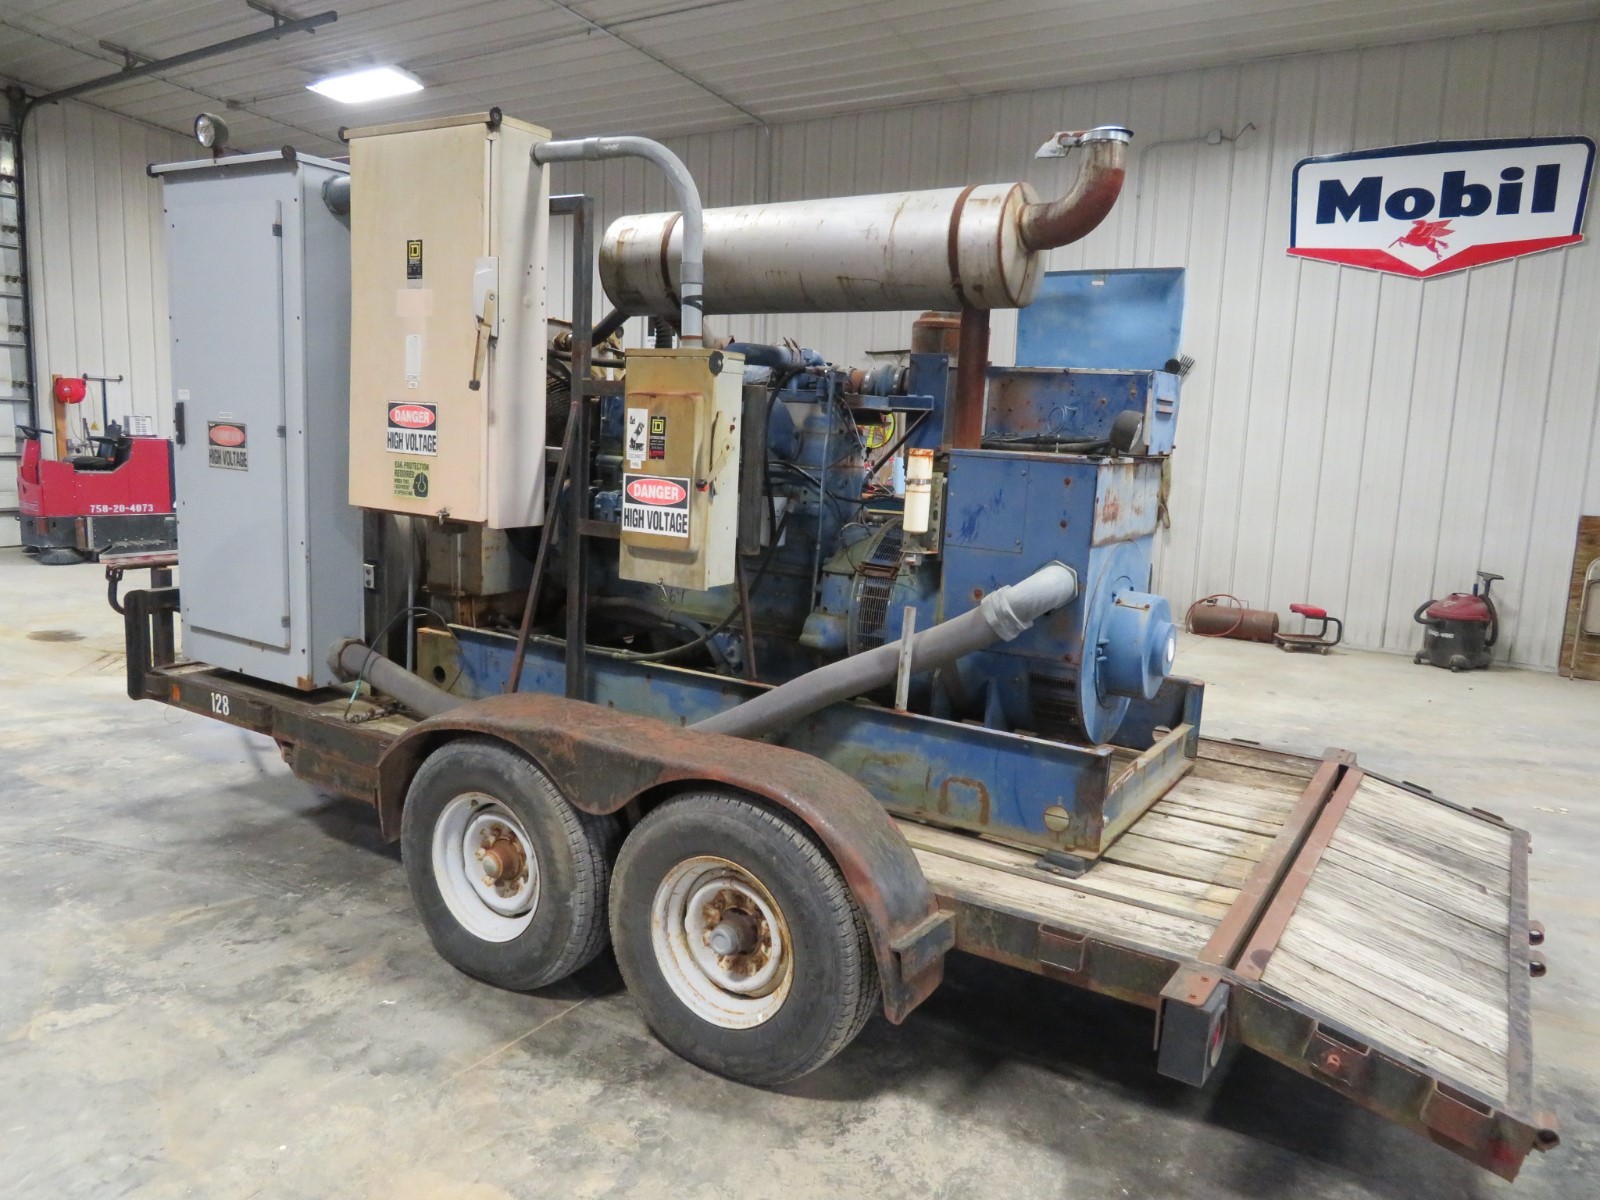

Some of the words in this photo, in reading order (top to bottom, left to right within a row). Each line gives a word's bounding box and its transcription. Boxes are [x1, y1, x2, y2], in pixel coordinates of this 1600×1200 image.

[1316, 164, 1560, 224] Mobil
[395, 410, 429, 424] DANGER
[387, 432, 403, 450] HIGH
[405, 433, 436, 452] VOLTAGE
[633, 483, 679, 500] DANGER
[624, 508, 645, 528] HIGH
[647, 510, 688, 533] VOLTAGE
[210, 692, 229, 715] 128
